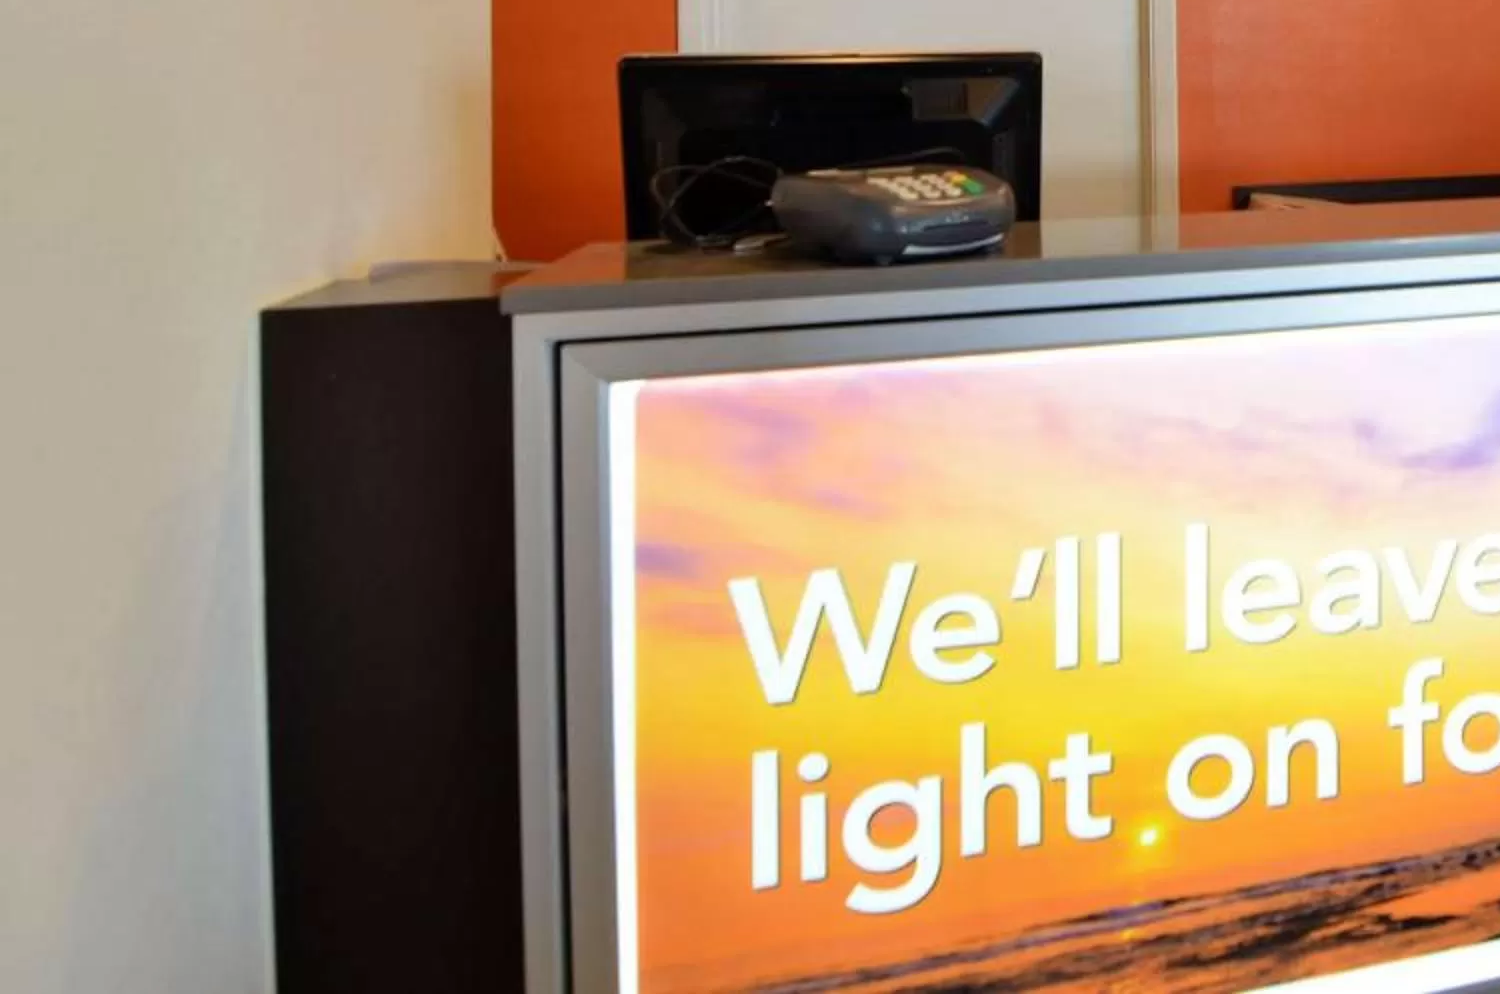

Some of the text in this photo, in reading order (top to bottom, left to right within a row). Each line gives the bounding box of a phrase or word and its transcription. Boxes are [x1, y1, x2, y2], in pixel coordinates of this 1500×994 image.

[728, 531, 1122, 707] We'll
[751, 721, 1115, 916] light
[1165, 712, 1340, 821] on
